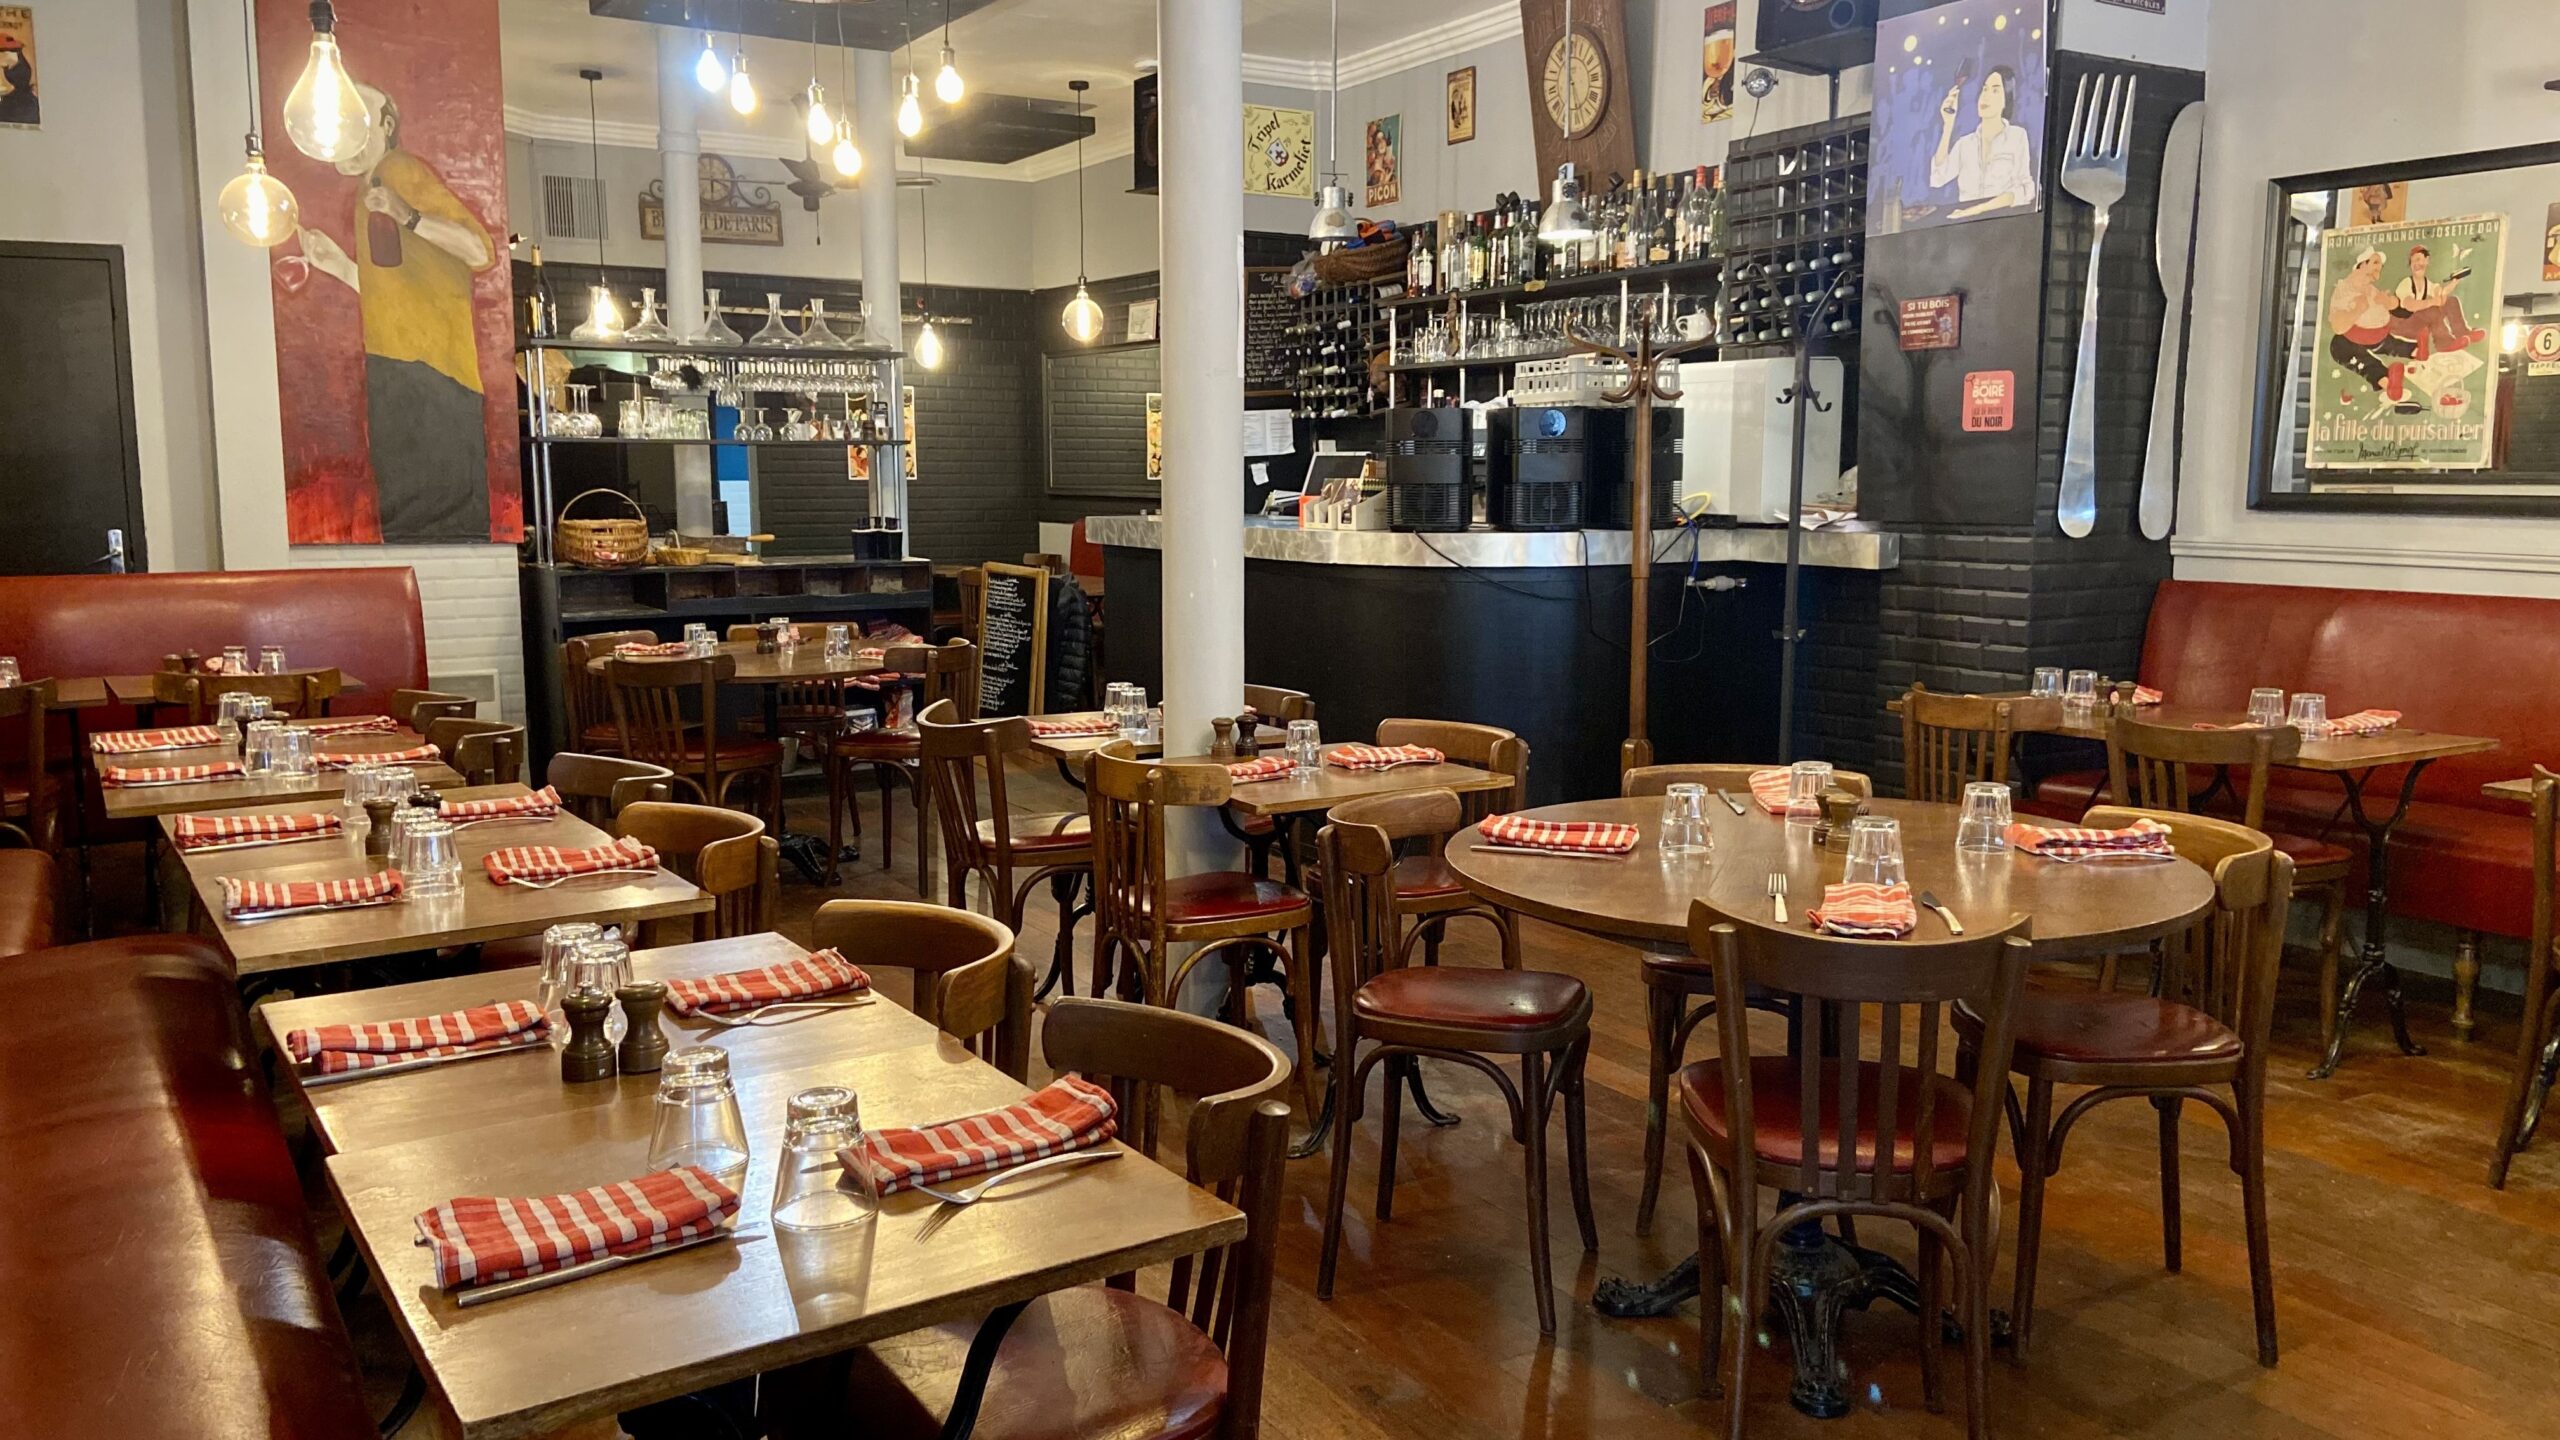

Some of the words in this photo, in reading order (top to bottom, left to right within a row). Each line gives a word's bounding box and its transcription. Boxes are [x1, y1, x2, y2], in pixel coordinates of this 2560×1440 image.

[1248, 111, 1280, 152] Tripel
[1266, 138, 1311, 190] Karmeliet
[1368, 184, 1396, 203] PICON
[714, 213, 733, 231] DE
[735, 215, 773, 233] PARIS
[2366, 228, 2426, 246] FERNANDEL
[2430, 223, 2474, 238] JOSETTE
[1907, 302, 1916, 311] SI
[1917, 301, 1928, 310] TU
[1929, 299, 1950, 309] BOIS
[2543, 332, 2552, 351] 6
[1972, 384, 2005, 398] BOIRE
[1971, 416, 1982, 428] DU
[1984, 416, 2003, 428] NOIR
[2314, 420, 2330, 441] la
[2332, 414, 2368, 441] fille
[2371, 419, 2395, 441] du
[2398, 419, 2484, 446] puisatier
